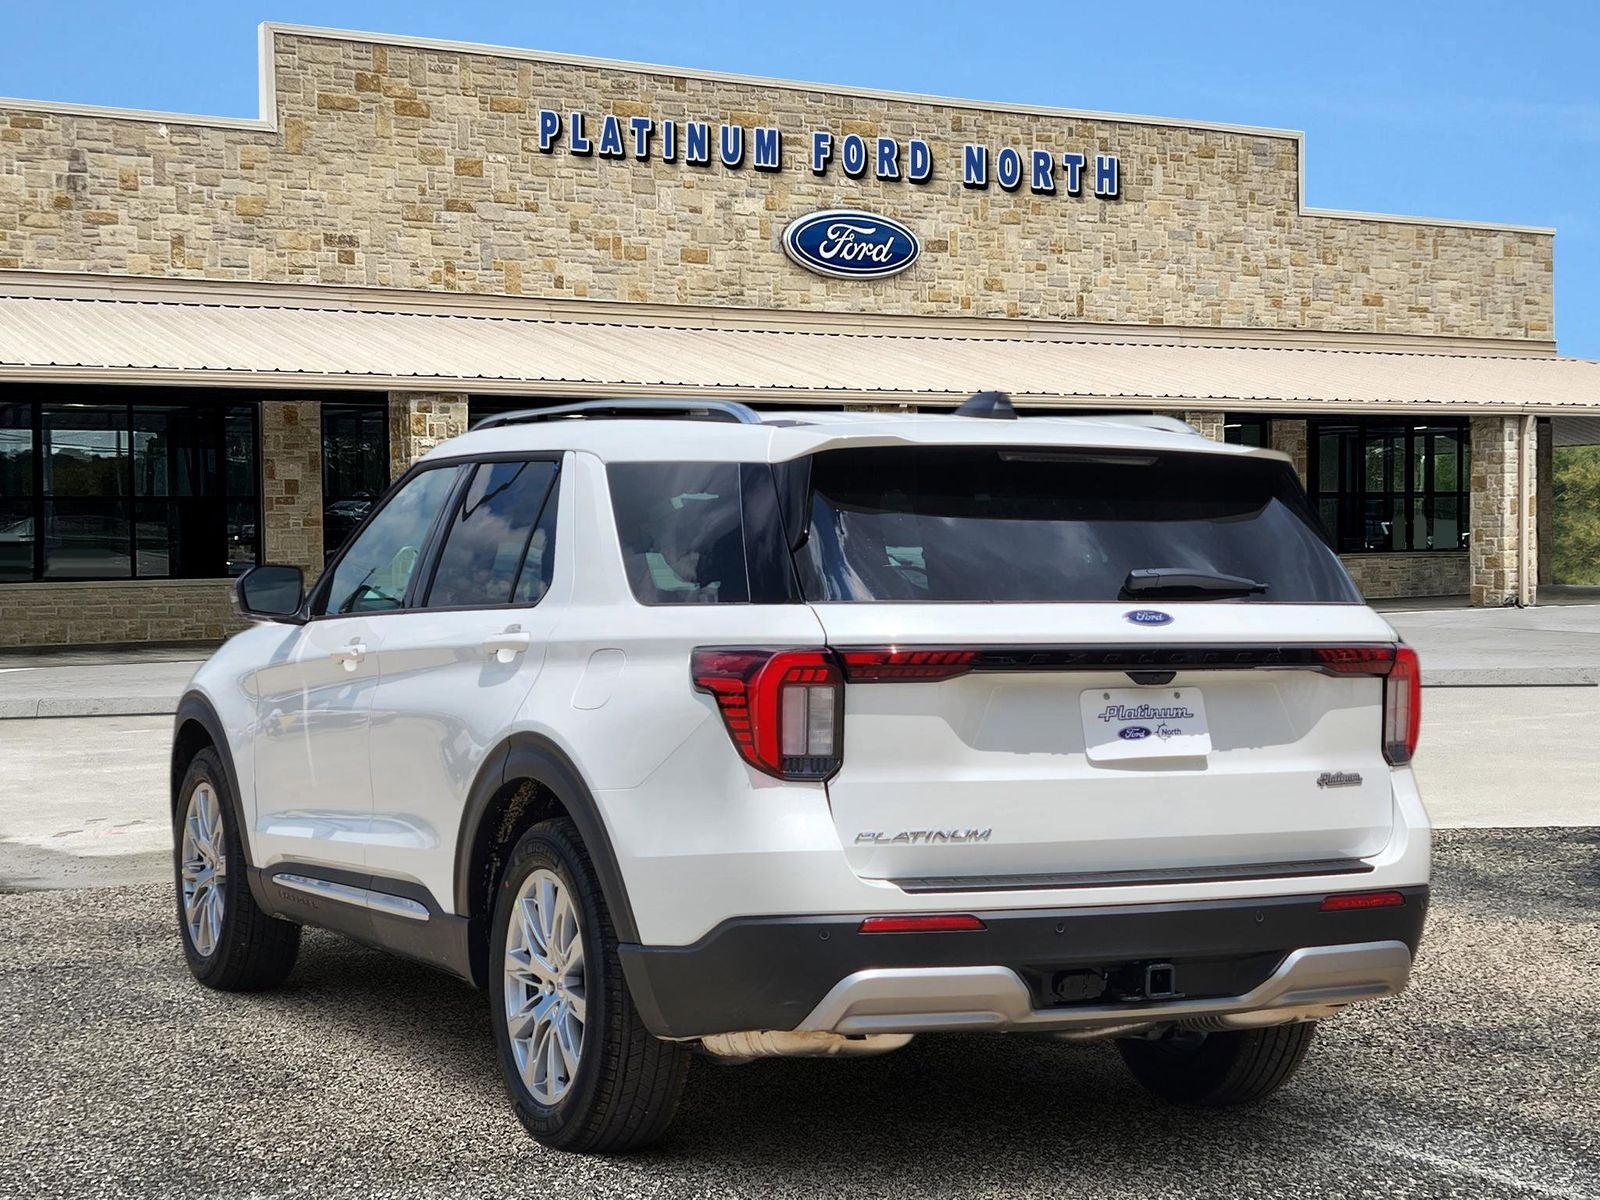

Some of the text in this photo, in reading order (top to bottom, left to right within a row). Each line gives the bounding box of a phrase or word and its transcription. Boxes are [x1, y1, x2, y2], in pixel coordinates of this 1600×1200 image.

[538, 109, 1121, 199] PLATINUM FORD NORTH
[819, 223, 894, 266] Ford
[1097, 704, 1195, 722] Platinum
[1161, 728, 1182, 736] North
[854, 828, 992, 844] PLATINUM
